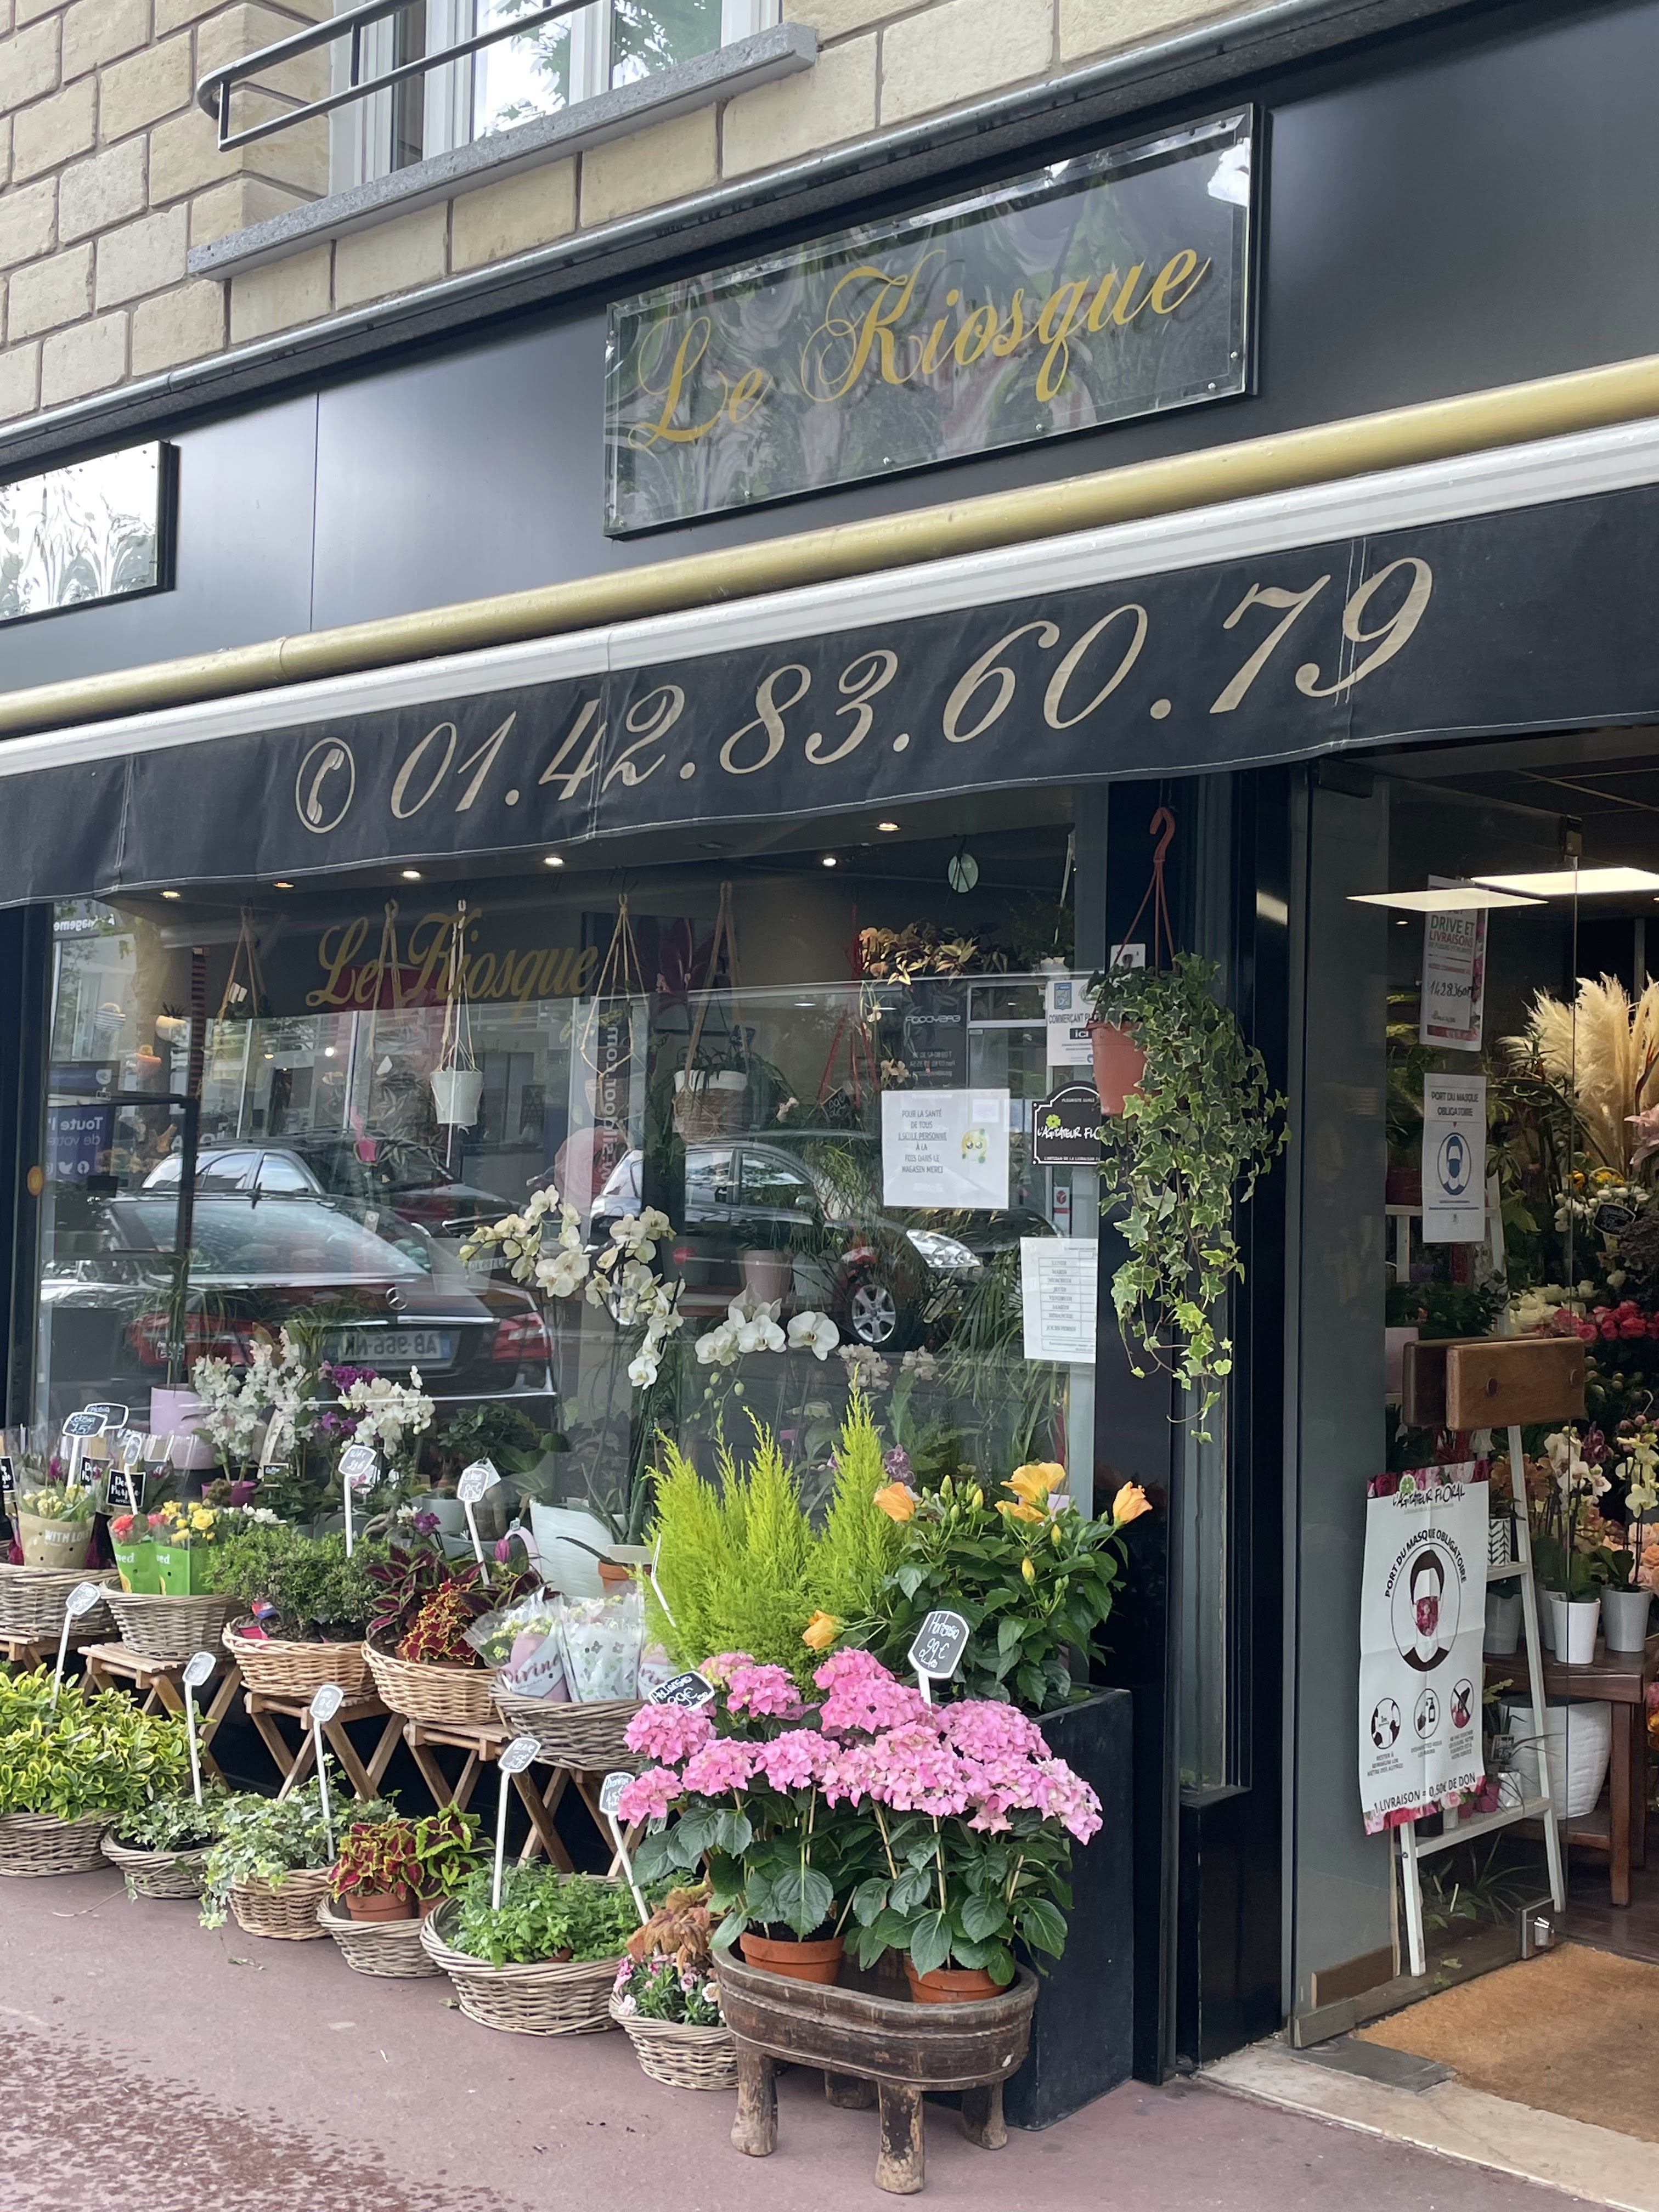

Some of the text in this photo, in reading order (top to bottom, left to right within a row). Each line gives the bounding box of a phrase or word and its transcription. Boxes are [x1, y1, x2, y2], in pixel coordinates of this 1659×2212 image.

[628, 248, 1211, 450] Le Kiosque
[391, 557, 1432, 819] 01.42.83.60.79
[1431, 915, 1475, 936] DRIVE ET
[1429, 930, 1474, 947] LIVRAISONS
[306, 907, 599, 1024] Le Kiosque
[1431, 1091, 1447, 1101] PORT
[1447, 1092, 1455, 1101] DU
[926, 1108, 942, 1118] SANTÉ
[1437, 1106, 1473, 1116] OBLIGATOIRE
[919, 1132, 947, 1141] PERSONNE
[1037, 1125, 1082, 1139] L'AGITATEUR
[916, 1141, 921, 1150] À
[933, 1154, 940, 1163] LE
[1385, 1528, 1466, 1598] PORT DU MASQUE OBLIGATOIRE
[1380, 1790, 1420, 1812] LIVRAISON
[1448, 1778, 1457, 1790] DE
[1459, 1772, 1476, 1787] DON
